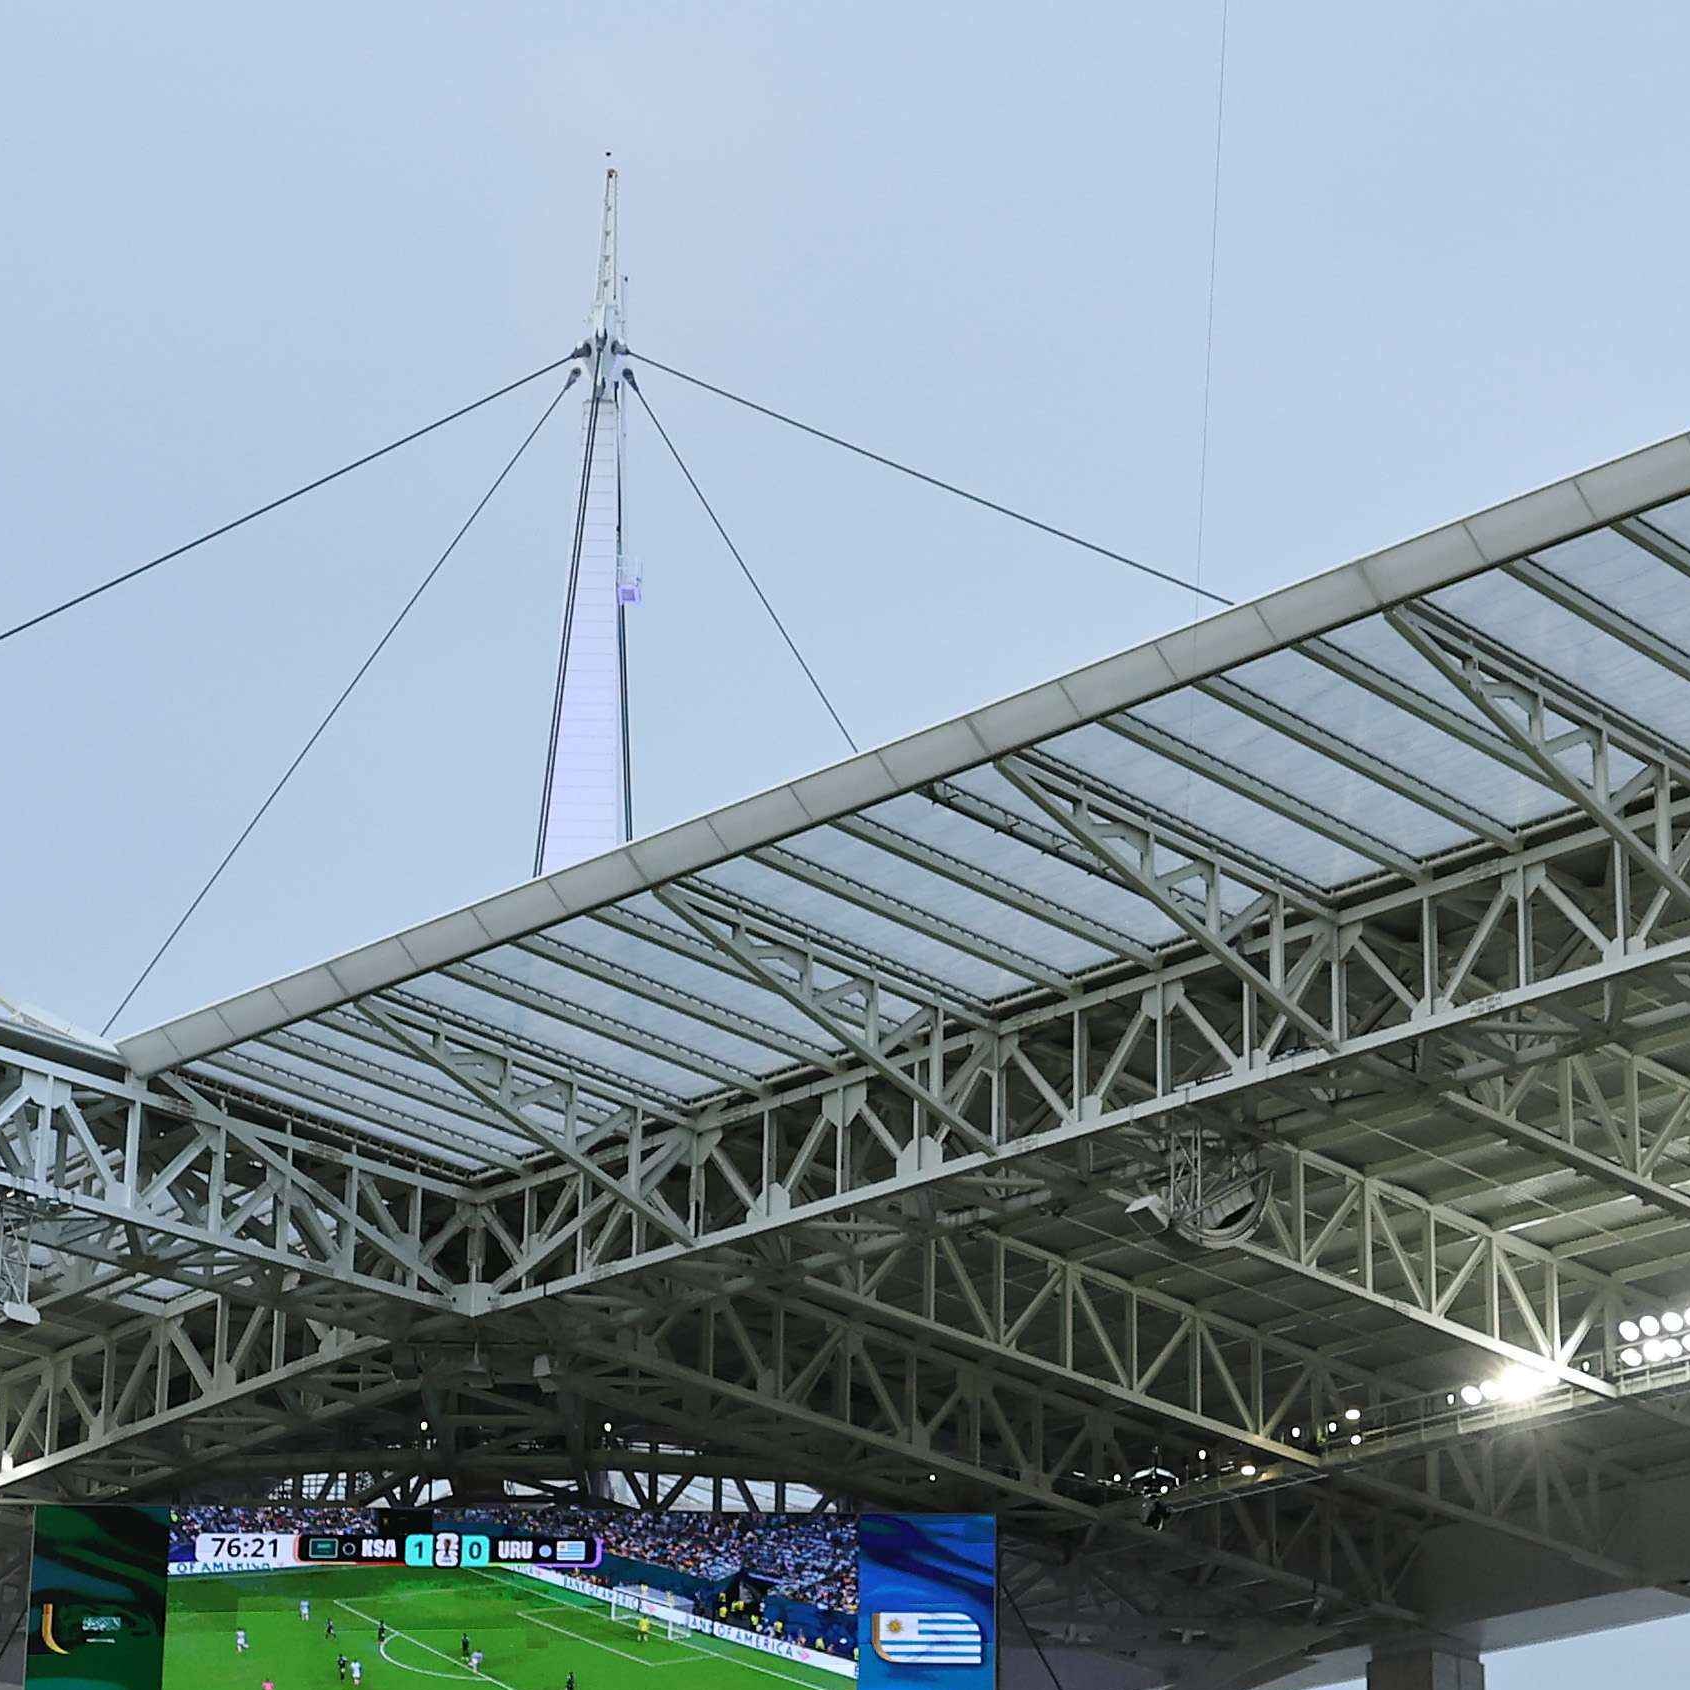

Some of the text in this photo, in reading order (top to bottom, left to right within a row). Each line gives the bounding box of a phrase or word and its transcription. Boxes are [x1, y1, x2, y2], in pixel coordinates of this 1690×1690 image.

[211, 1537, 532, 1559] 76:21 KSA 1 0 URU
